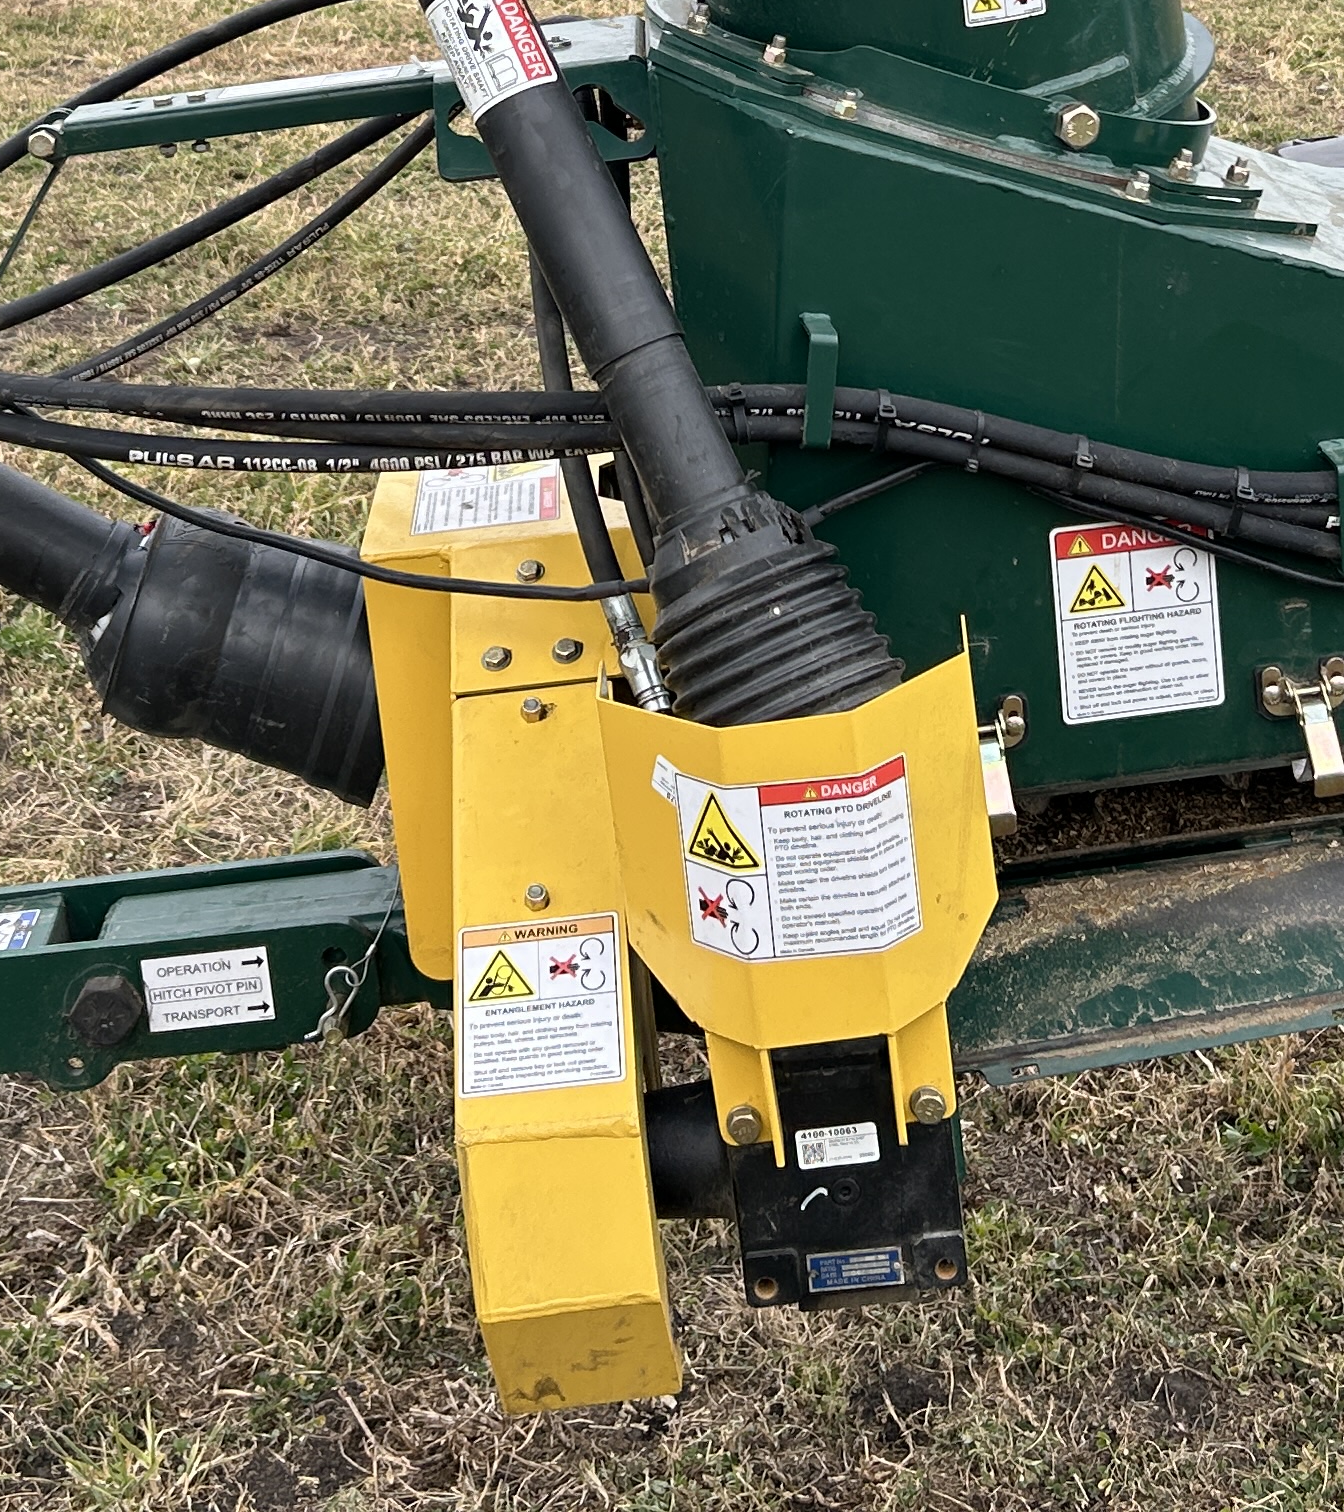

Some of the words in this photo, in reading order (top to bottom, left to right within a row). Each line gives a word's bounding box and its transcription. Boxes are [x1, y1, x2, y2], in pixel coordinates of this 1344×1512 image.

[441, 32, 456, 59] KEEP
[501, 2, 546, 77] DANGER
[443, 6, 464, 44] ROTATING
[462, 47, 477, 70] DRIVE
[473, 72, 489, 98] SHAFT
[129, 449, 234, 470] PULSAR
[243, 457, 318, 471] 112CC-08
[326, 458, 359, 472] 1/2"
[369, 457, 410, 471] 4000
[415, 455, 440, 470] PSI
[445, 454, 452, 468] /
[456, 451, 486, 467] 275
[491, 450, 523, 465] BAR
[1073, 618, 1117, 630] ROTATING
[1119, 612, 1163, 624] FLIGHTING
[1167, 607, 1201, 618] HAZARD
[820, 774, 877, 796] DANGER
[783, 806, 831, 818] ROTATING
[834, 805, 853, 813] PTO
[856, 789, 892, 811] DRIVELINE
[515, 924, 578, 939] WARNING
[157, 960, 231, 978] OPERATION
[153, 988, 191, 1001] HITCH
[195, 983, 233, 996] PIVOT
[237, 980, 257, 991] PIN
[163, 1005, 240, 1023] TRANSPORT
[485, 1002, 556, 1016] ENTANGLEMENT
[558, 998, 594, 1008] HAZARD
[827, 1277, 848, 1285] MADE
